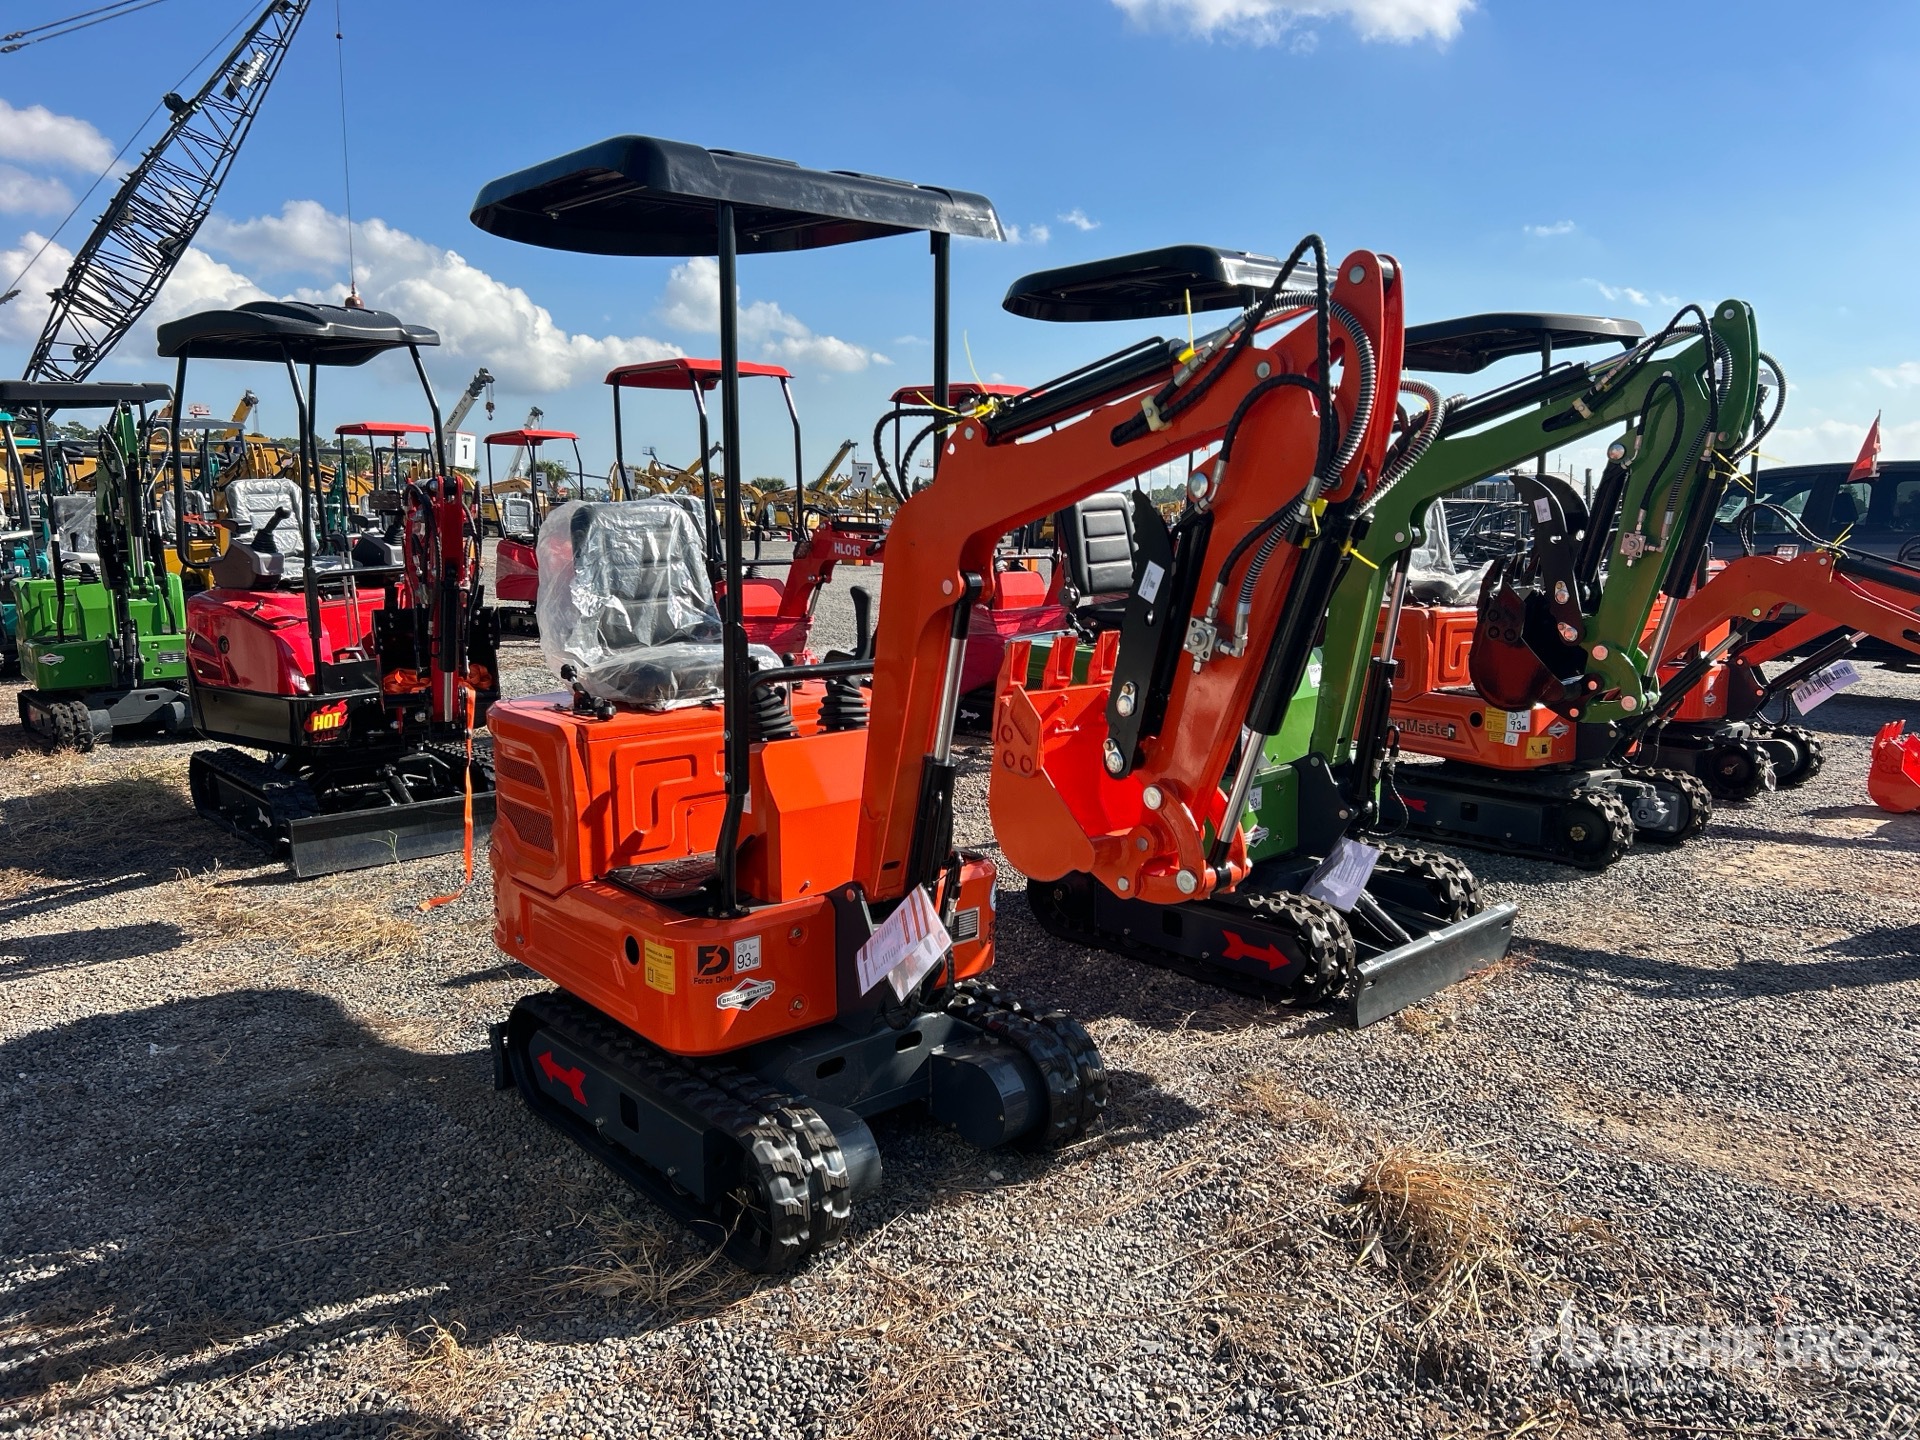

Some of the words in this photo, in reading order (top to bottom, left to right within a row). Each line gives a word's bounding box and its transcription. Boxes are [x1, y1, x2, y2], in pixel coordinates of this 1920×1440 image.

[463, 444, 468, 459] 1
[536, 477, 543, 487] 5
[858, 471, 867, 483] 7
[313, 712, 341, 731] HOT
[1510, 720, 1521, 731] 93
[737, 952, 752, 969] 93
[693, 977, 713, 985] Force
[715, 975, 733, 983] Drive
